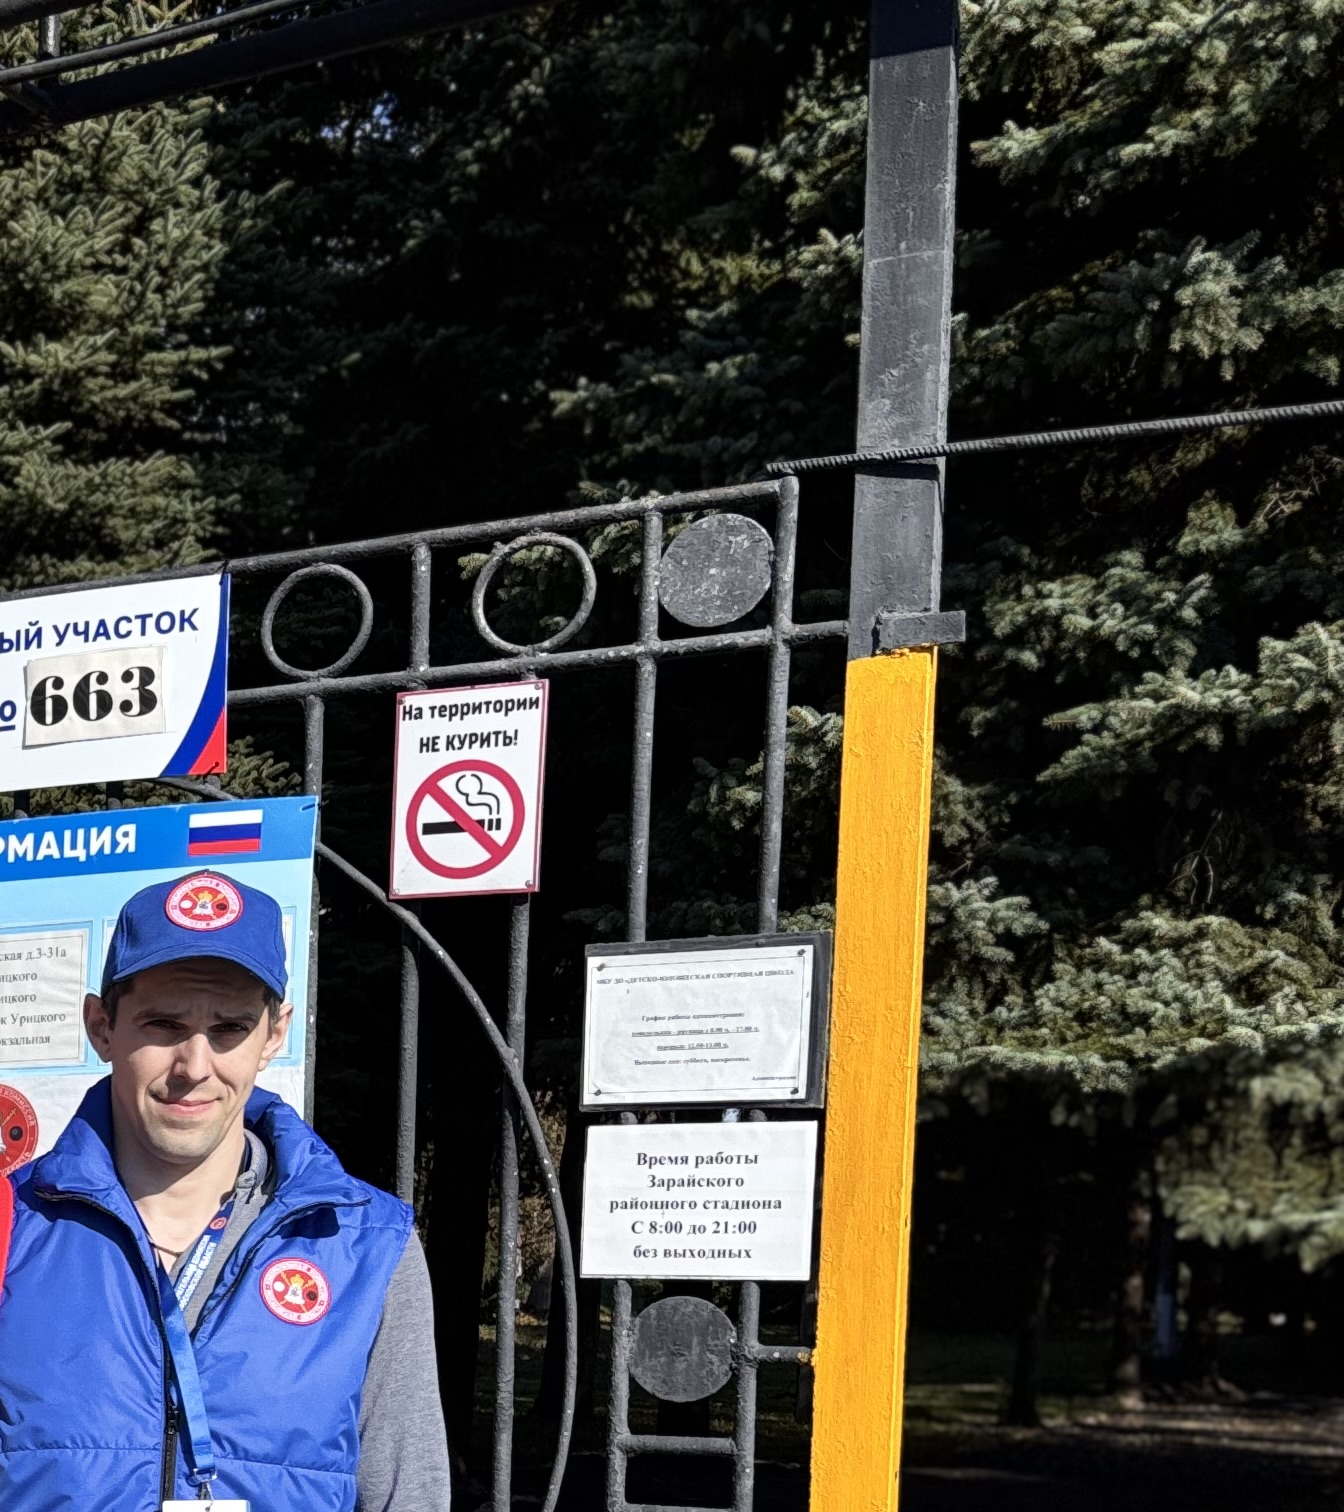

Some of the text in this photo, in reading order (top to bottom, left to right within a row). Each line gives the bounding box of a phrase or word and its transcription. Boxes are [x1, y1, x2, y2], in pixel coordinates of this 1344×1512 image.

[54, 608, 201, 647] УЧАСТОК
[29, 665, 159, 727] 663
[402, 696, 540, 722] На территории
[419, 729, 519, 754] НЕ КУРИТЬ!
[10, 1012, 67, 1027] Урицкого
[636, 1151, 759, 1169] Время работы
[646, 1174, 745, 1191] Зарайского
[609, 1196, 782, 1213] районного стадиона
[631, 1220, 757, 1235] С 8:00 до 21:00
[633, 1245, 753, 1260] без выходных
